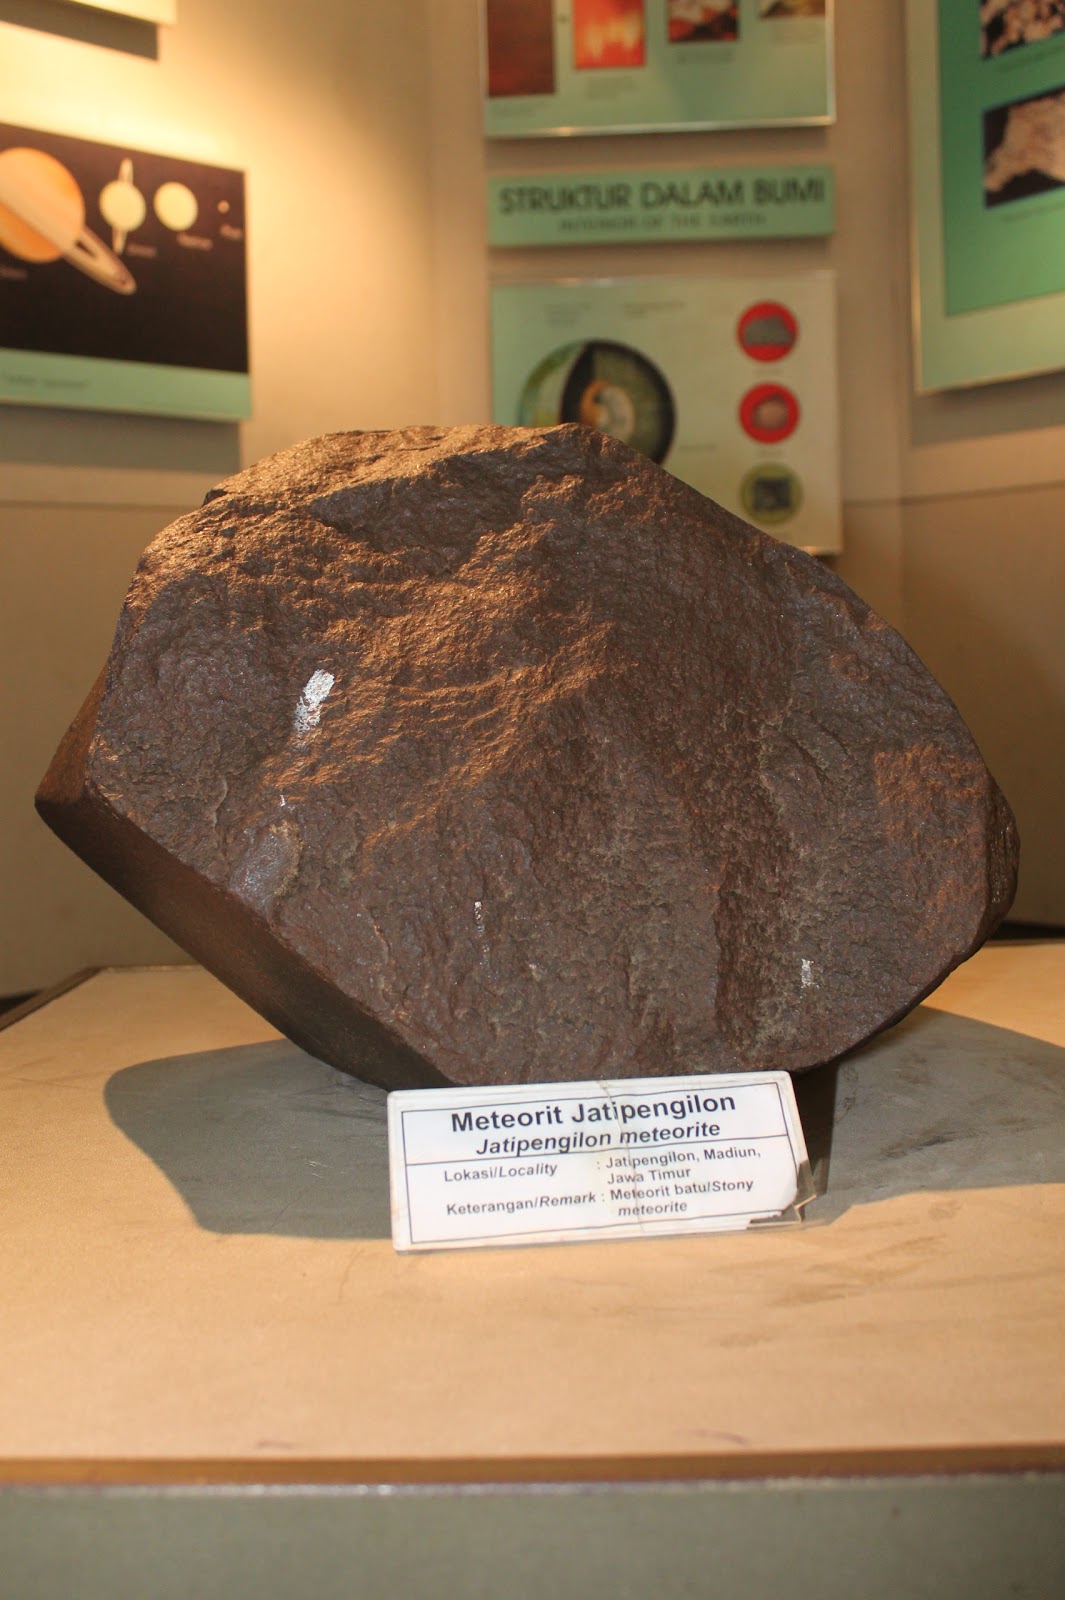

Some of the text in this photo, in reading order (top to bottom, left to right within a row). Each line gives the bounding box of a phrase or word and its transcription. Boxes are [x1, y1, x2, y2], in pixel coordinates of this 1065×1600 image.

[499, 178, 824, 214] STRUKTUR DALAM BUMI
[452, 1094, 736, 1132] Meteorit Jatipengilon
[476, 1122, 721, 1155] Jatipengilon meteorite
[444, 1162, 558, 1182] Lokasi/Locality
[606, 1149, 700, 1169] Jatipengilon,
[704, 1146, 761, 1160] Madiun,
[607, 1166, 690, 1185] Jawa Timur
[446, 1191, 596, 1216] Keterangan/Remark
[610, 1184, 670, 1202] Meteorit
[675, 1178, 754, 1196] batu/Stony
[618, 1200, 688, 1217] meteorite
